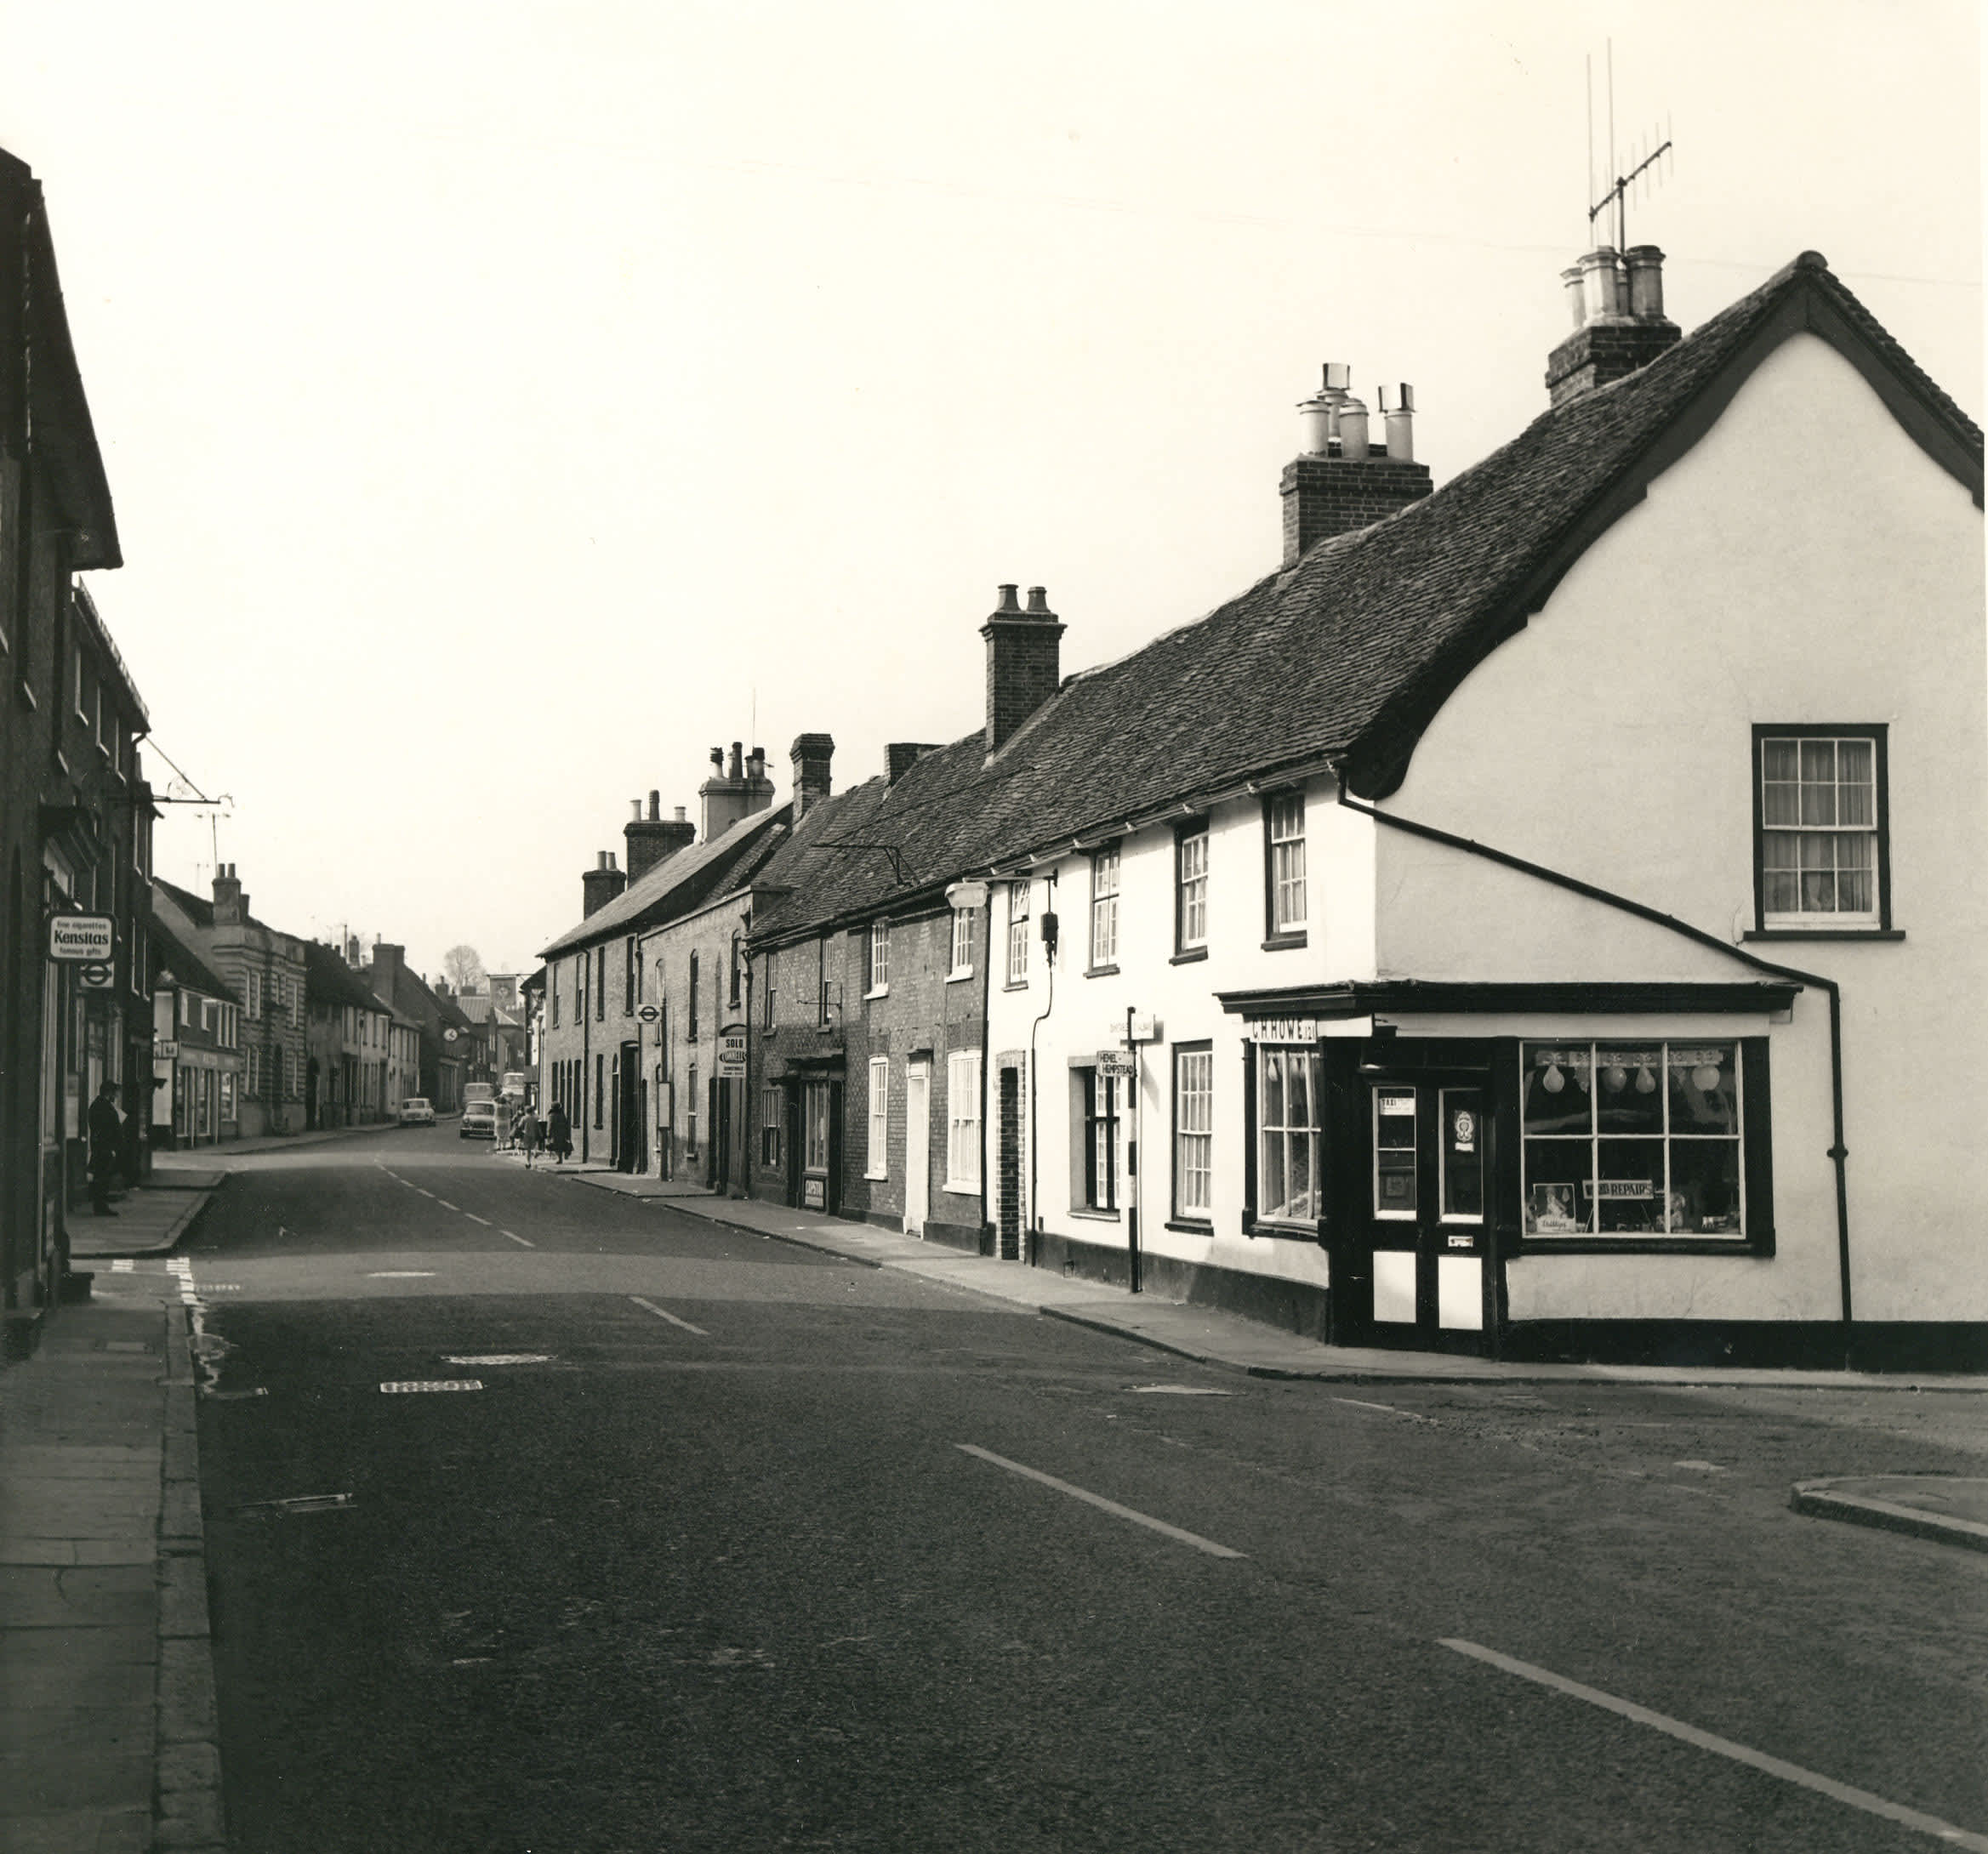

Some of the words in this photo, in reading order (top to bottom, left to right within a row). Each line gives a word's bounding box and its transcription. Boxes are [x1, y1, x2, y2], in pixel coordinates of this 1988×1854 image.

[54, 930, 109, 946] Kensitas
[725, 1038, 743, 1049] SOLD
[1100, 1053, 1118, 1063] HEMEL
[1102, 1064, 1134, 1075] HEMPSTEAD
[1610, 1183, 1652, 1197] REPAIRS
